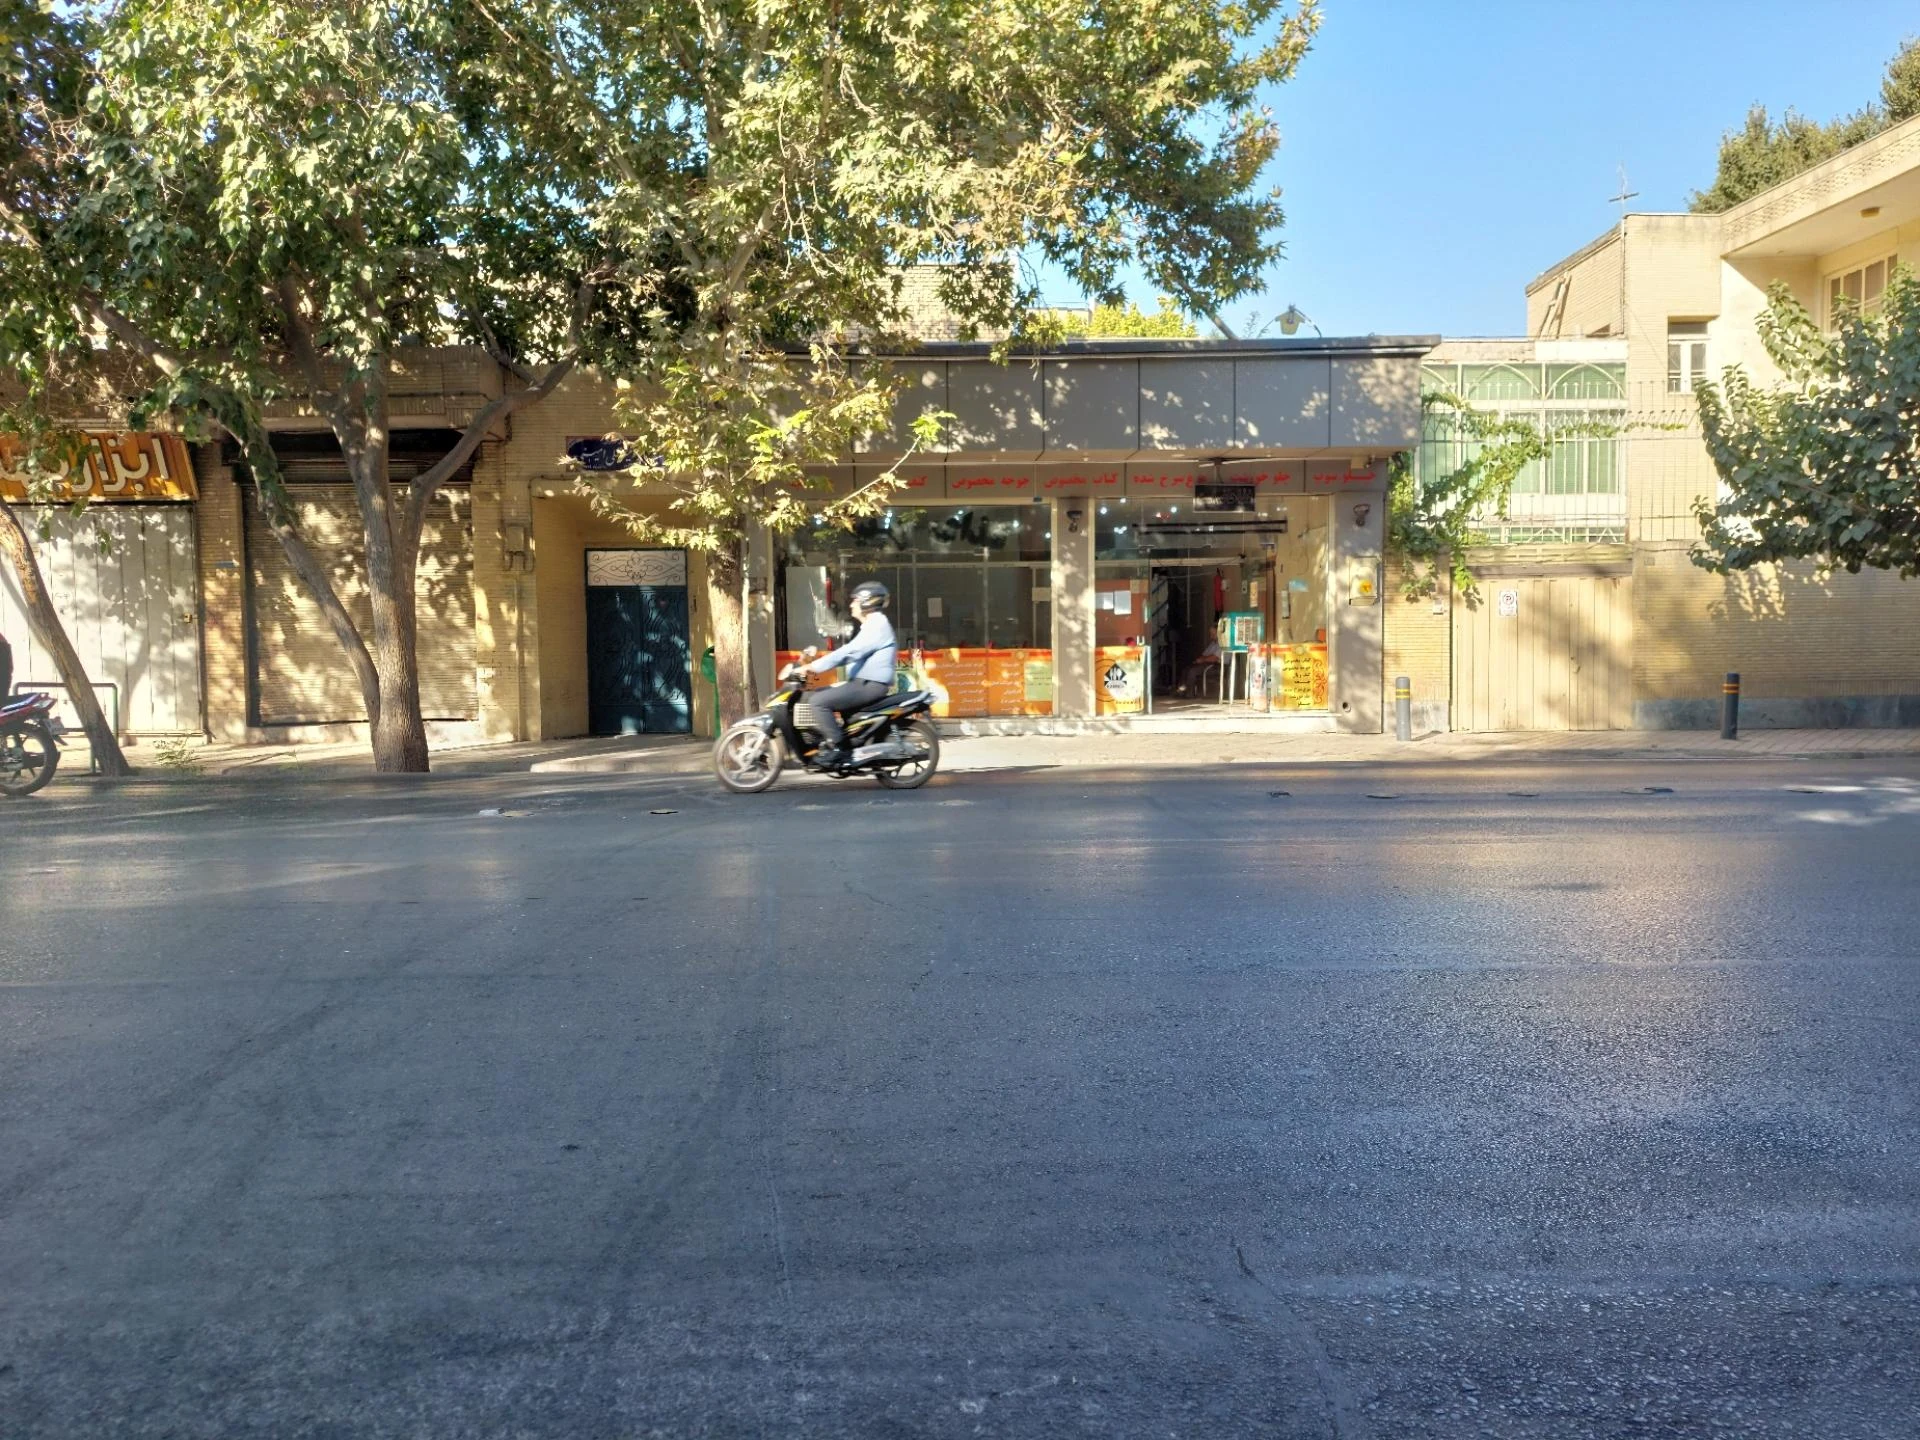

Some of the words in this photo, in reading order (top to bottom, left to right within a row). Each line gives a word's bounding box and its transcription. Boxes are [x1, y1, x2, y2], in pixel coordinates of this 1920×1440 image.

[72, 437, 169, 493] ابزار
[951, 475, 995, 490] مخصوص
[1044, 474, 1088, 490] مخصوص
